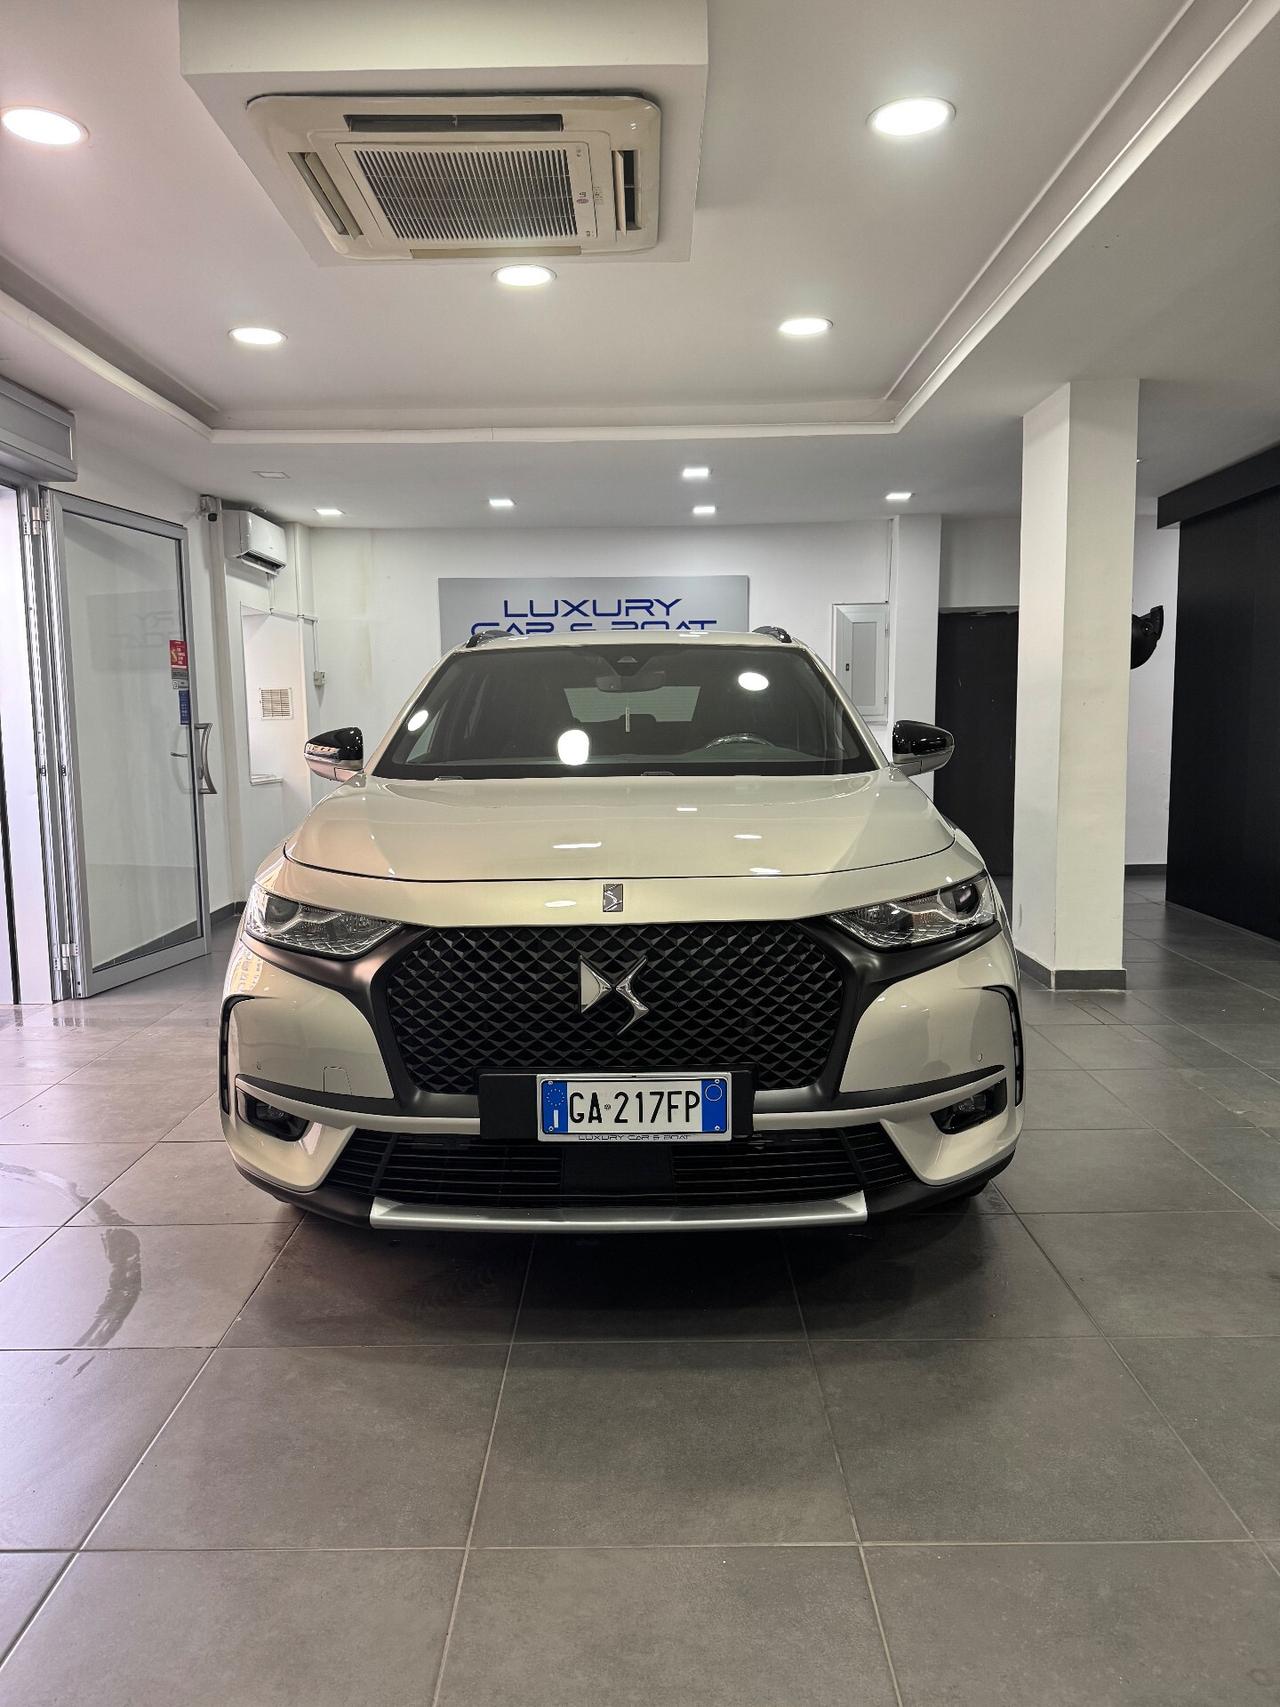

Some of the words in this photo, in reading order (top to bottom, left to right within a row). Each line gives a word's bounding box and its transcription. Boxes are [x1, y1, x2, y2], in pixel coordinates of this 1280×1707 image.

[503, 599, 682, 617] LUXURY
[569, 1092, 603, 1123] GA
[614, 1090, 700, 1123] 217FP
